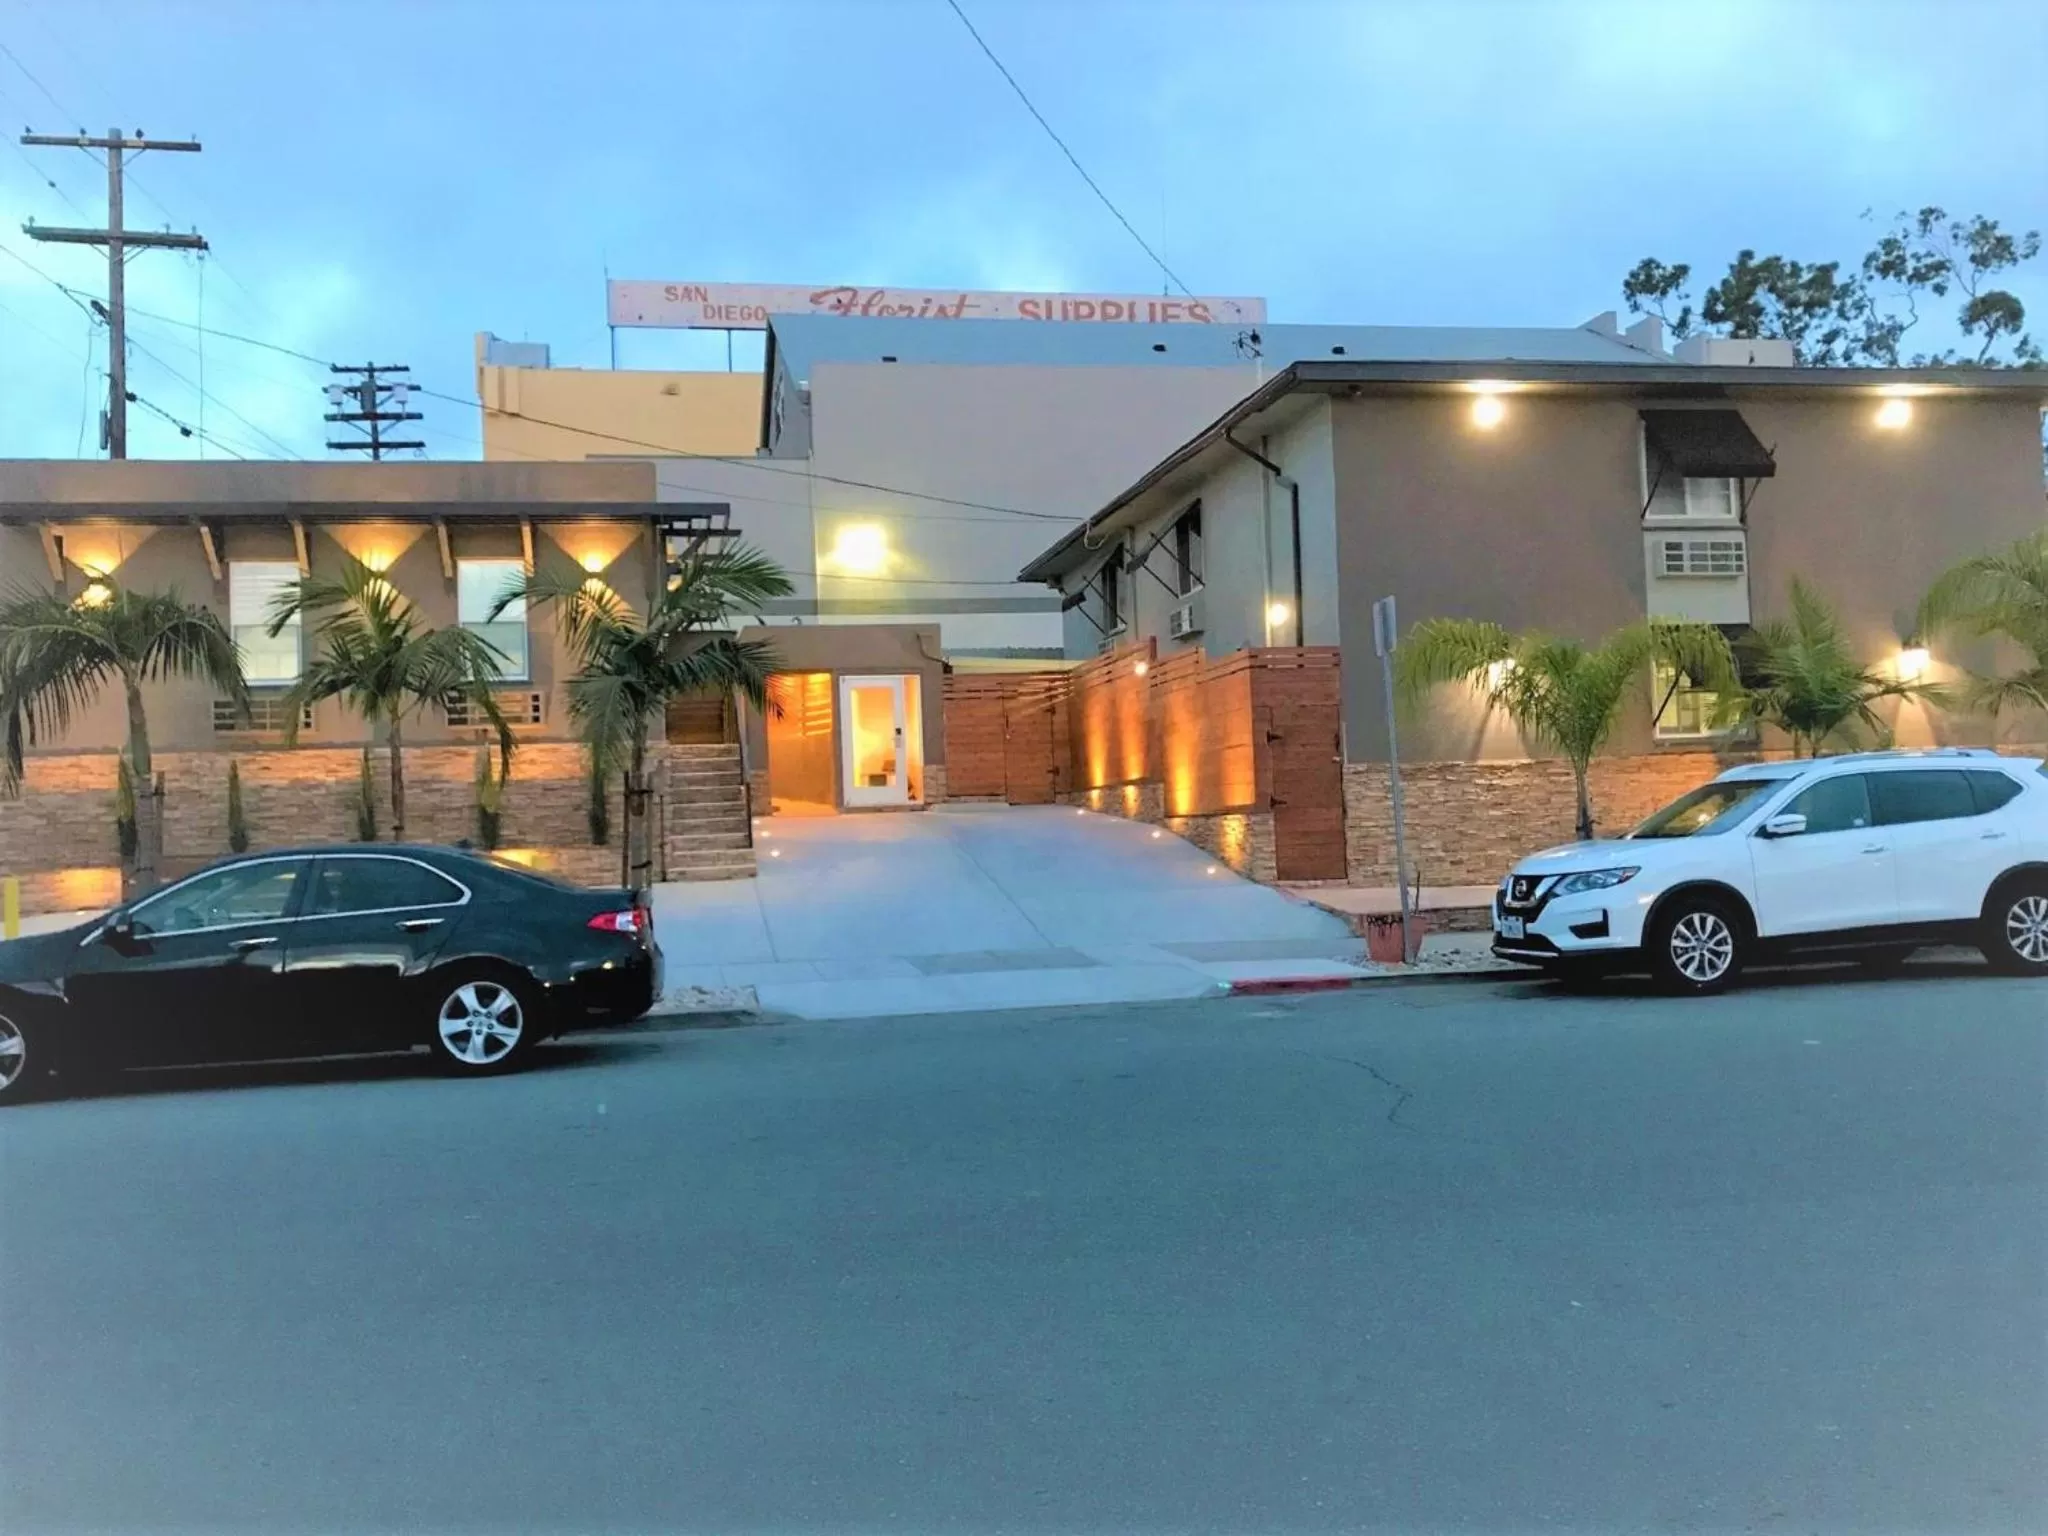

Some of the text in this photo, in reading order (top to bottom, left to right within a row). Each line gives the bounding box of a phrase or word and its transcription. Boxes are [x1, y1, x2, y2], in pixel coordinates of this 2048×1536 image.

[664, 285, 708, 302] SAN
[703, 304, 768, 321] DIEGO
[810, 287, 1212, 324] Florist SUPPLIES
